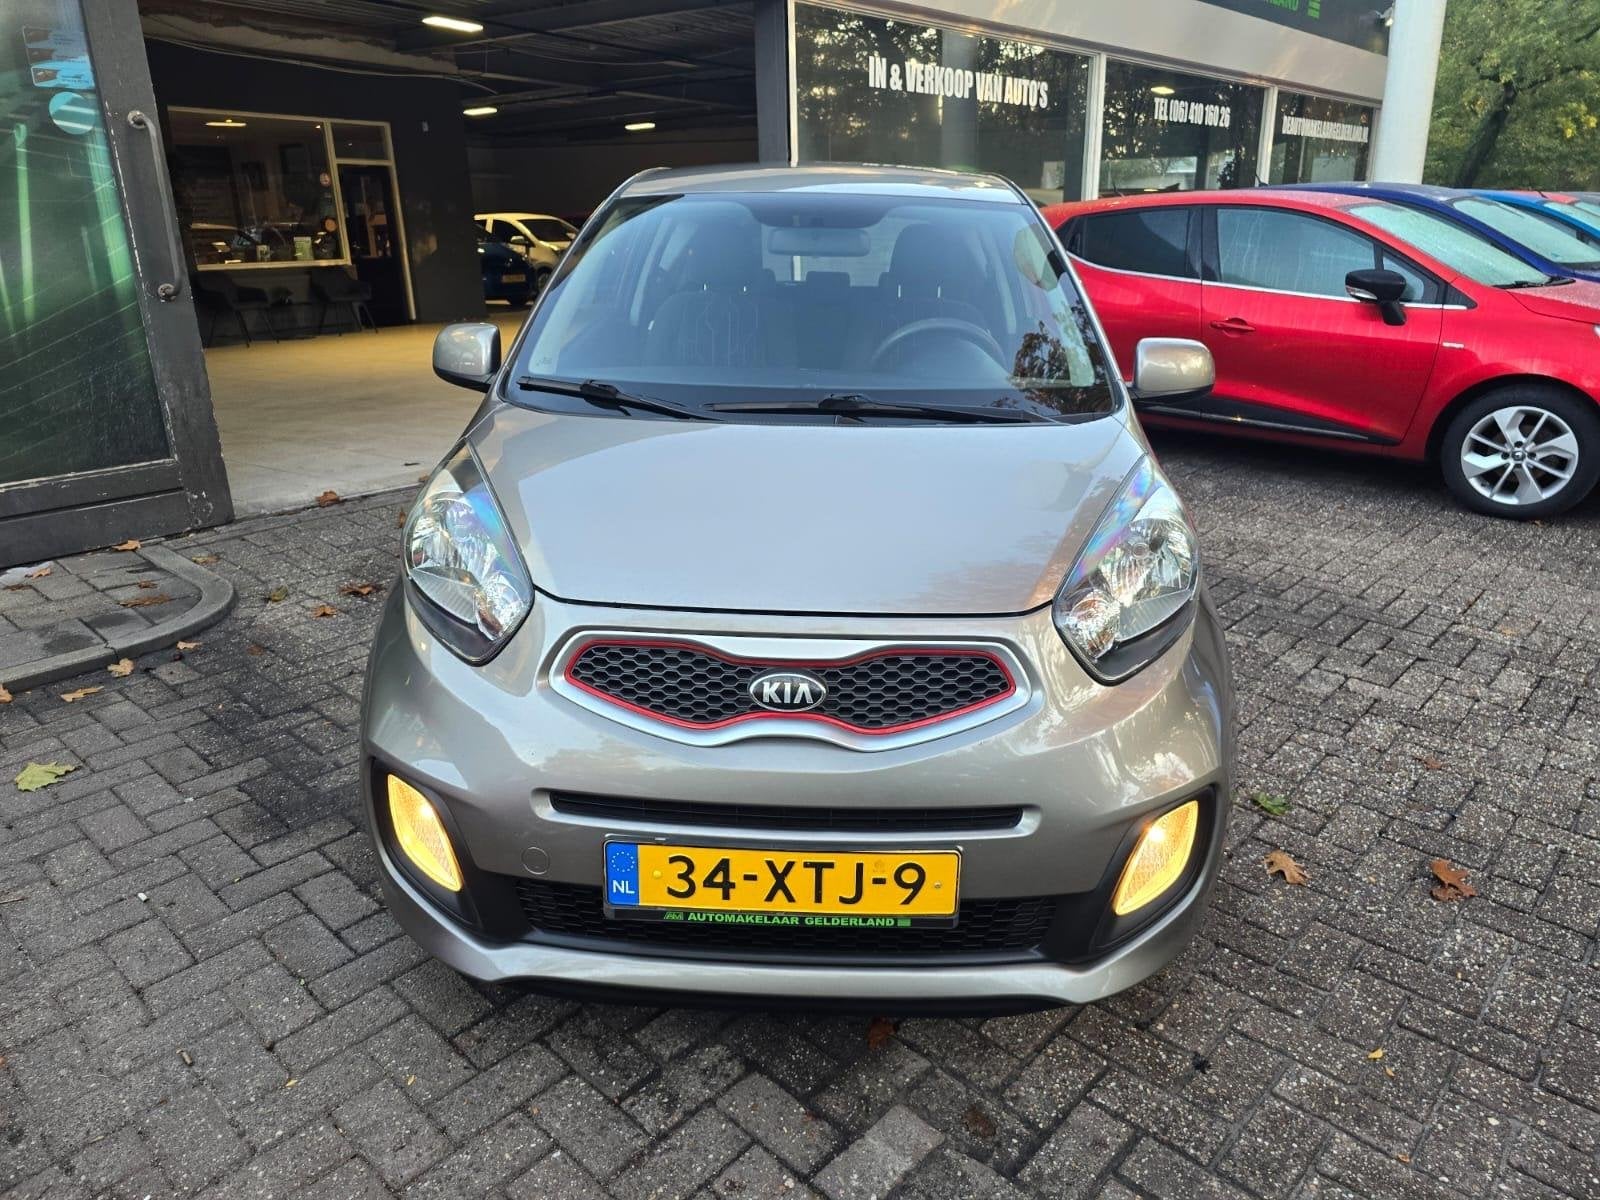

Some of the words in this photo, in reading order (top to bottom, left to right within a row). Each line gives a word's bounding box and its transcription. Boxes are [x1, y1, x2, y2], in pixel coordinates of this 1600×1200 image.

[868, 56, 887, 89] IN
[889, 64, 903, 91] &
[905, 60, 973, 99] VERKOOP
[975, 71, 1001, 103] VAN
[1004, 76, 1048, 109] AUTO'S
[1154, 97, 1168, 120] TEL
[1169, 99, 1188, 123] (06)
[1188, 102, 1204, 125] 410
[1205, 104, 1219, 127] 160
[1219, 105, 1231, 128] 26
[762, 681, 814, 704] KIA
[612, 879, 636, 895] NL
[666, 854, 927, 906] 34-XTJ-9
[687, 912, 800, 926] AUTOMAKELAAR
[804, 916, 895, 928] GELDERLAND
